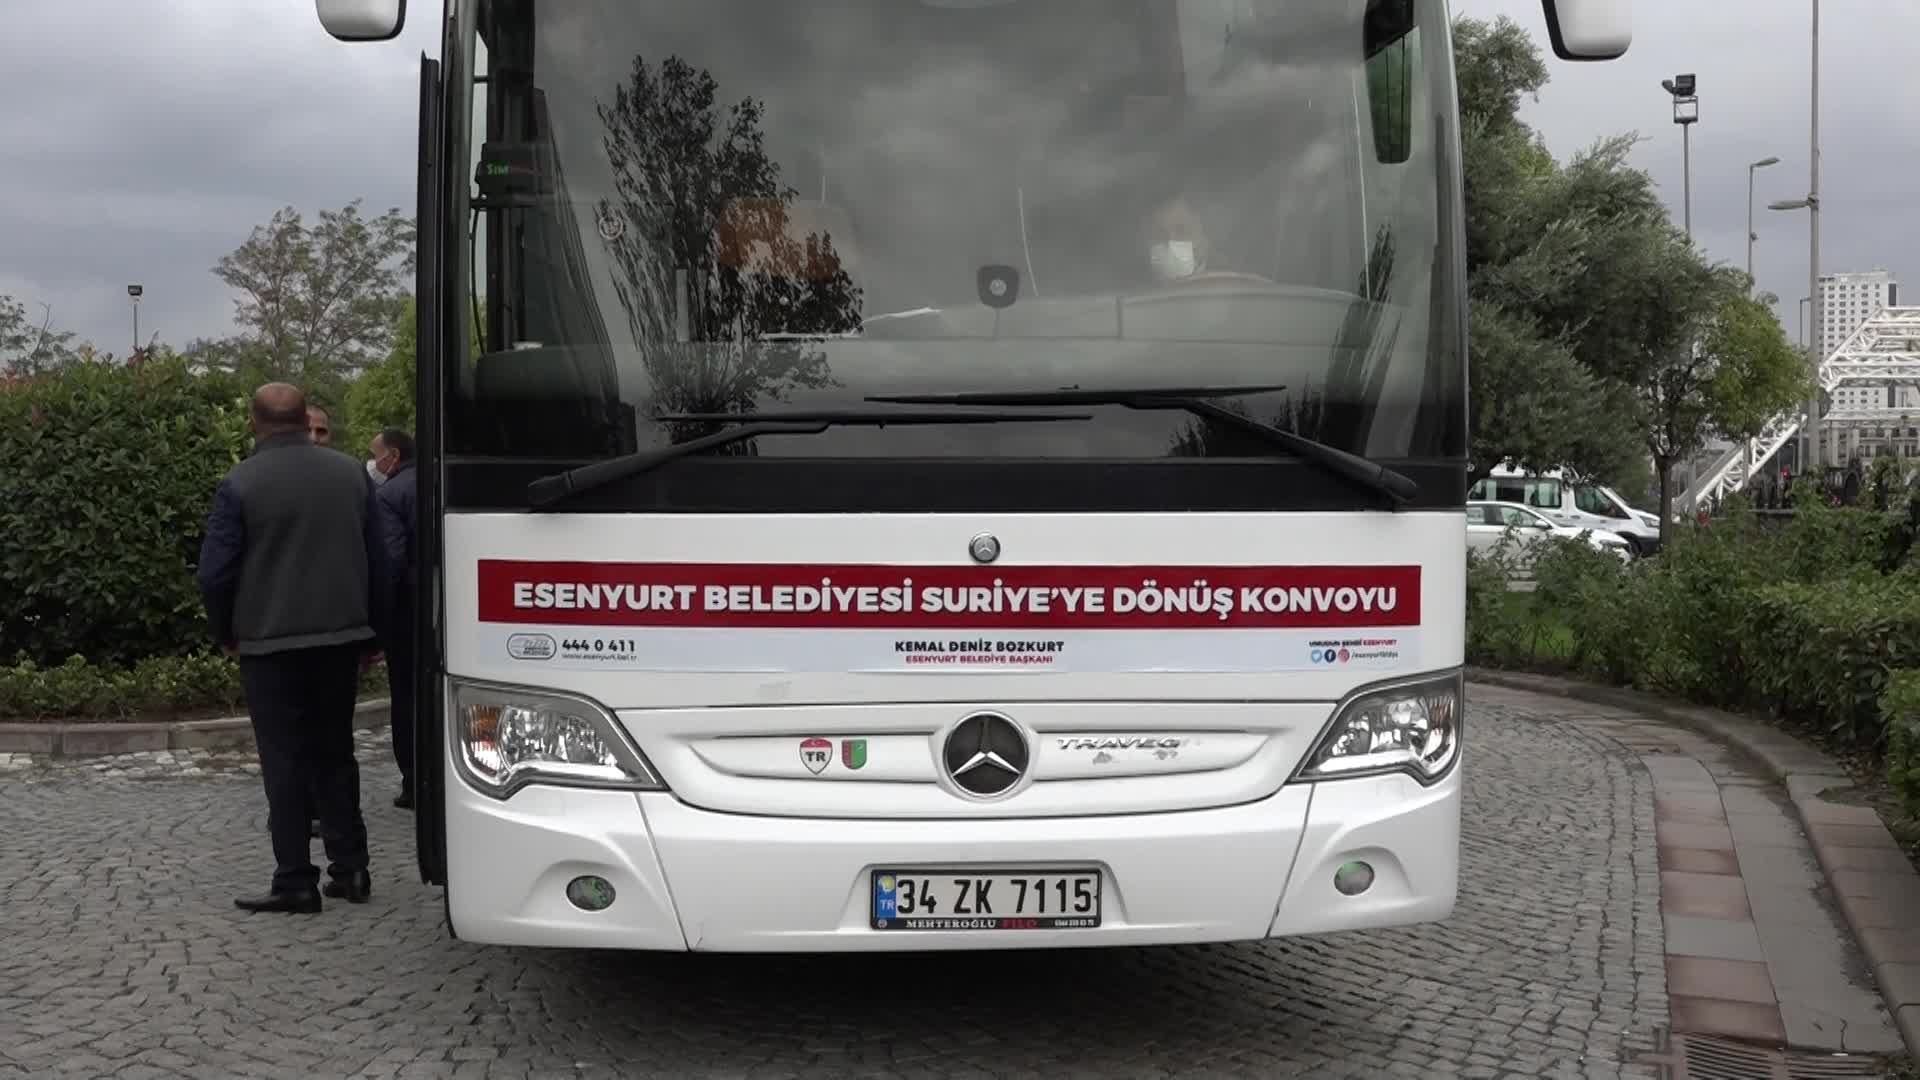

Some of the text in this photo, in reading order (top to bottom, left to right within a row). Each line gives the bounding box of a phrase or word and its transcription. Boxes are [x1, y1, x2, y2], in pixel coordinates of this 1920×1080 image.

[513, 577, 1397, 621] ESENYURT BELEDİYESİ SURİYE'YE DÖNÜŞ KONVOYU
[562, 639, 590, 651] 444
[594, 639, 604, 652] 0
[608, 639, 635, 652] 411
[895, 637, 1065, 652] KEMAL DENİZ BOZKURT
[905, 654, 1053, 665] ESENYURT BELEDİYE BAŞKANI
[805, 751, 826, 762] TR
[897, 879, 1092, 914] 34 ZK 7115
[880, 900, 896, 910] TR
[905, 918, 997, 929] MEHTEROĞLU
